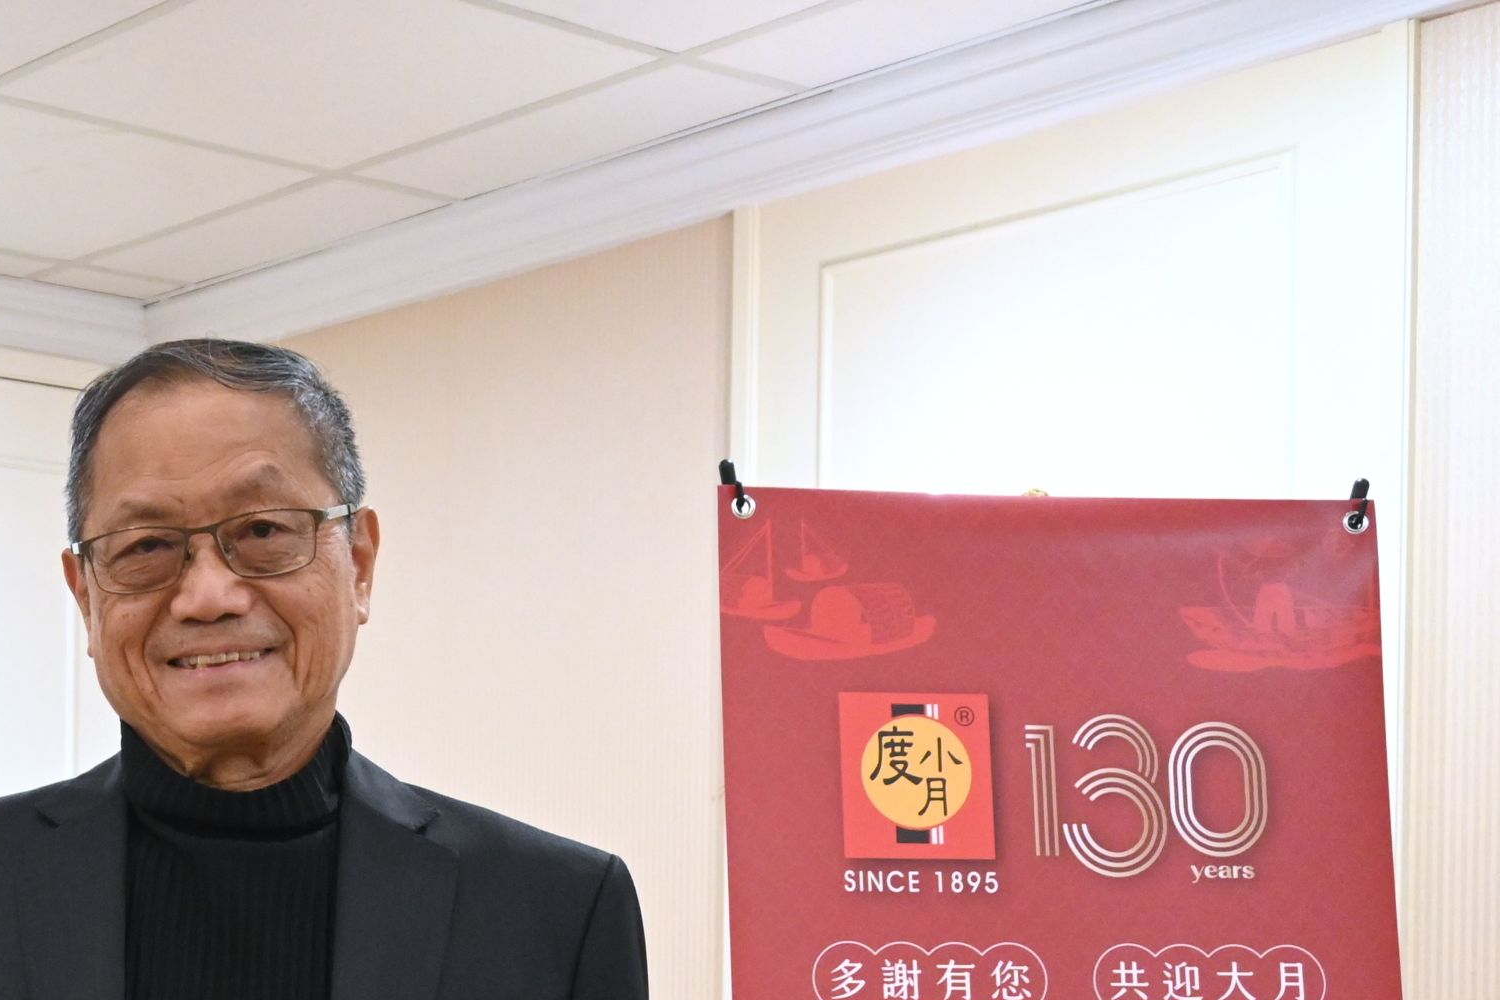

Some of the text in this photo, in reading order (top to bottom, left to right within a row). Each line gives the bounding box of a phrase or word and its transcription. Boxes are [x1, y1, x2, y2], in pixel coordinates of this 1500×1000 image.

[869, 725, 964, 817] 度小月
[1024, 713, 1269, 878] 130
[843, 869, 999, 894] SINCE 1895
[1190, 860, 1256, 883] years
